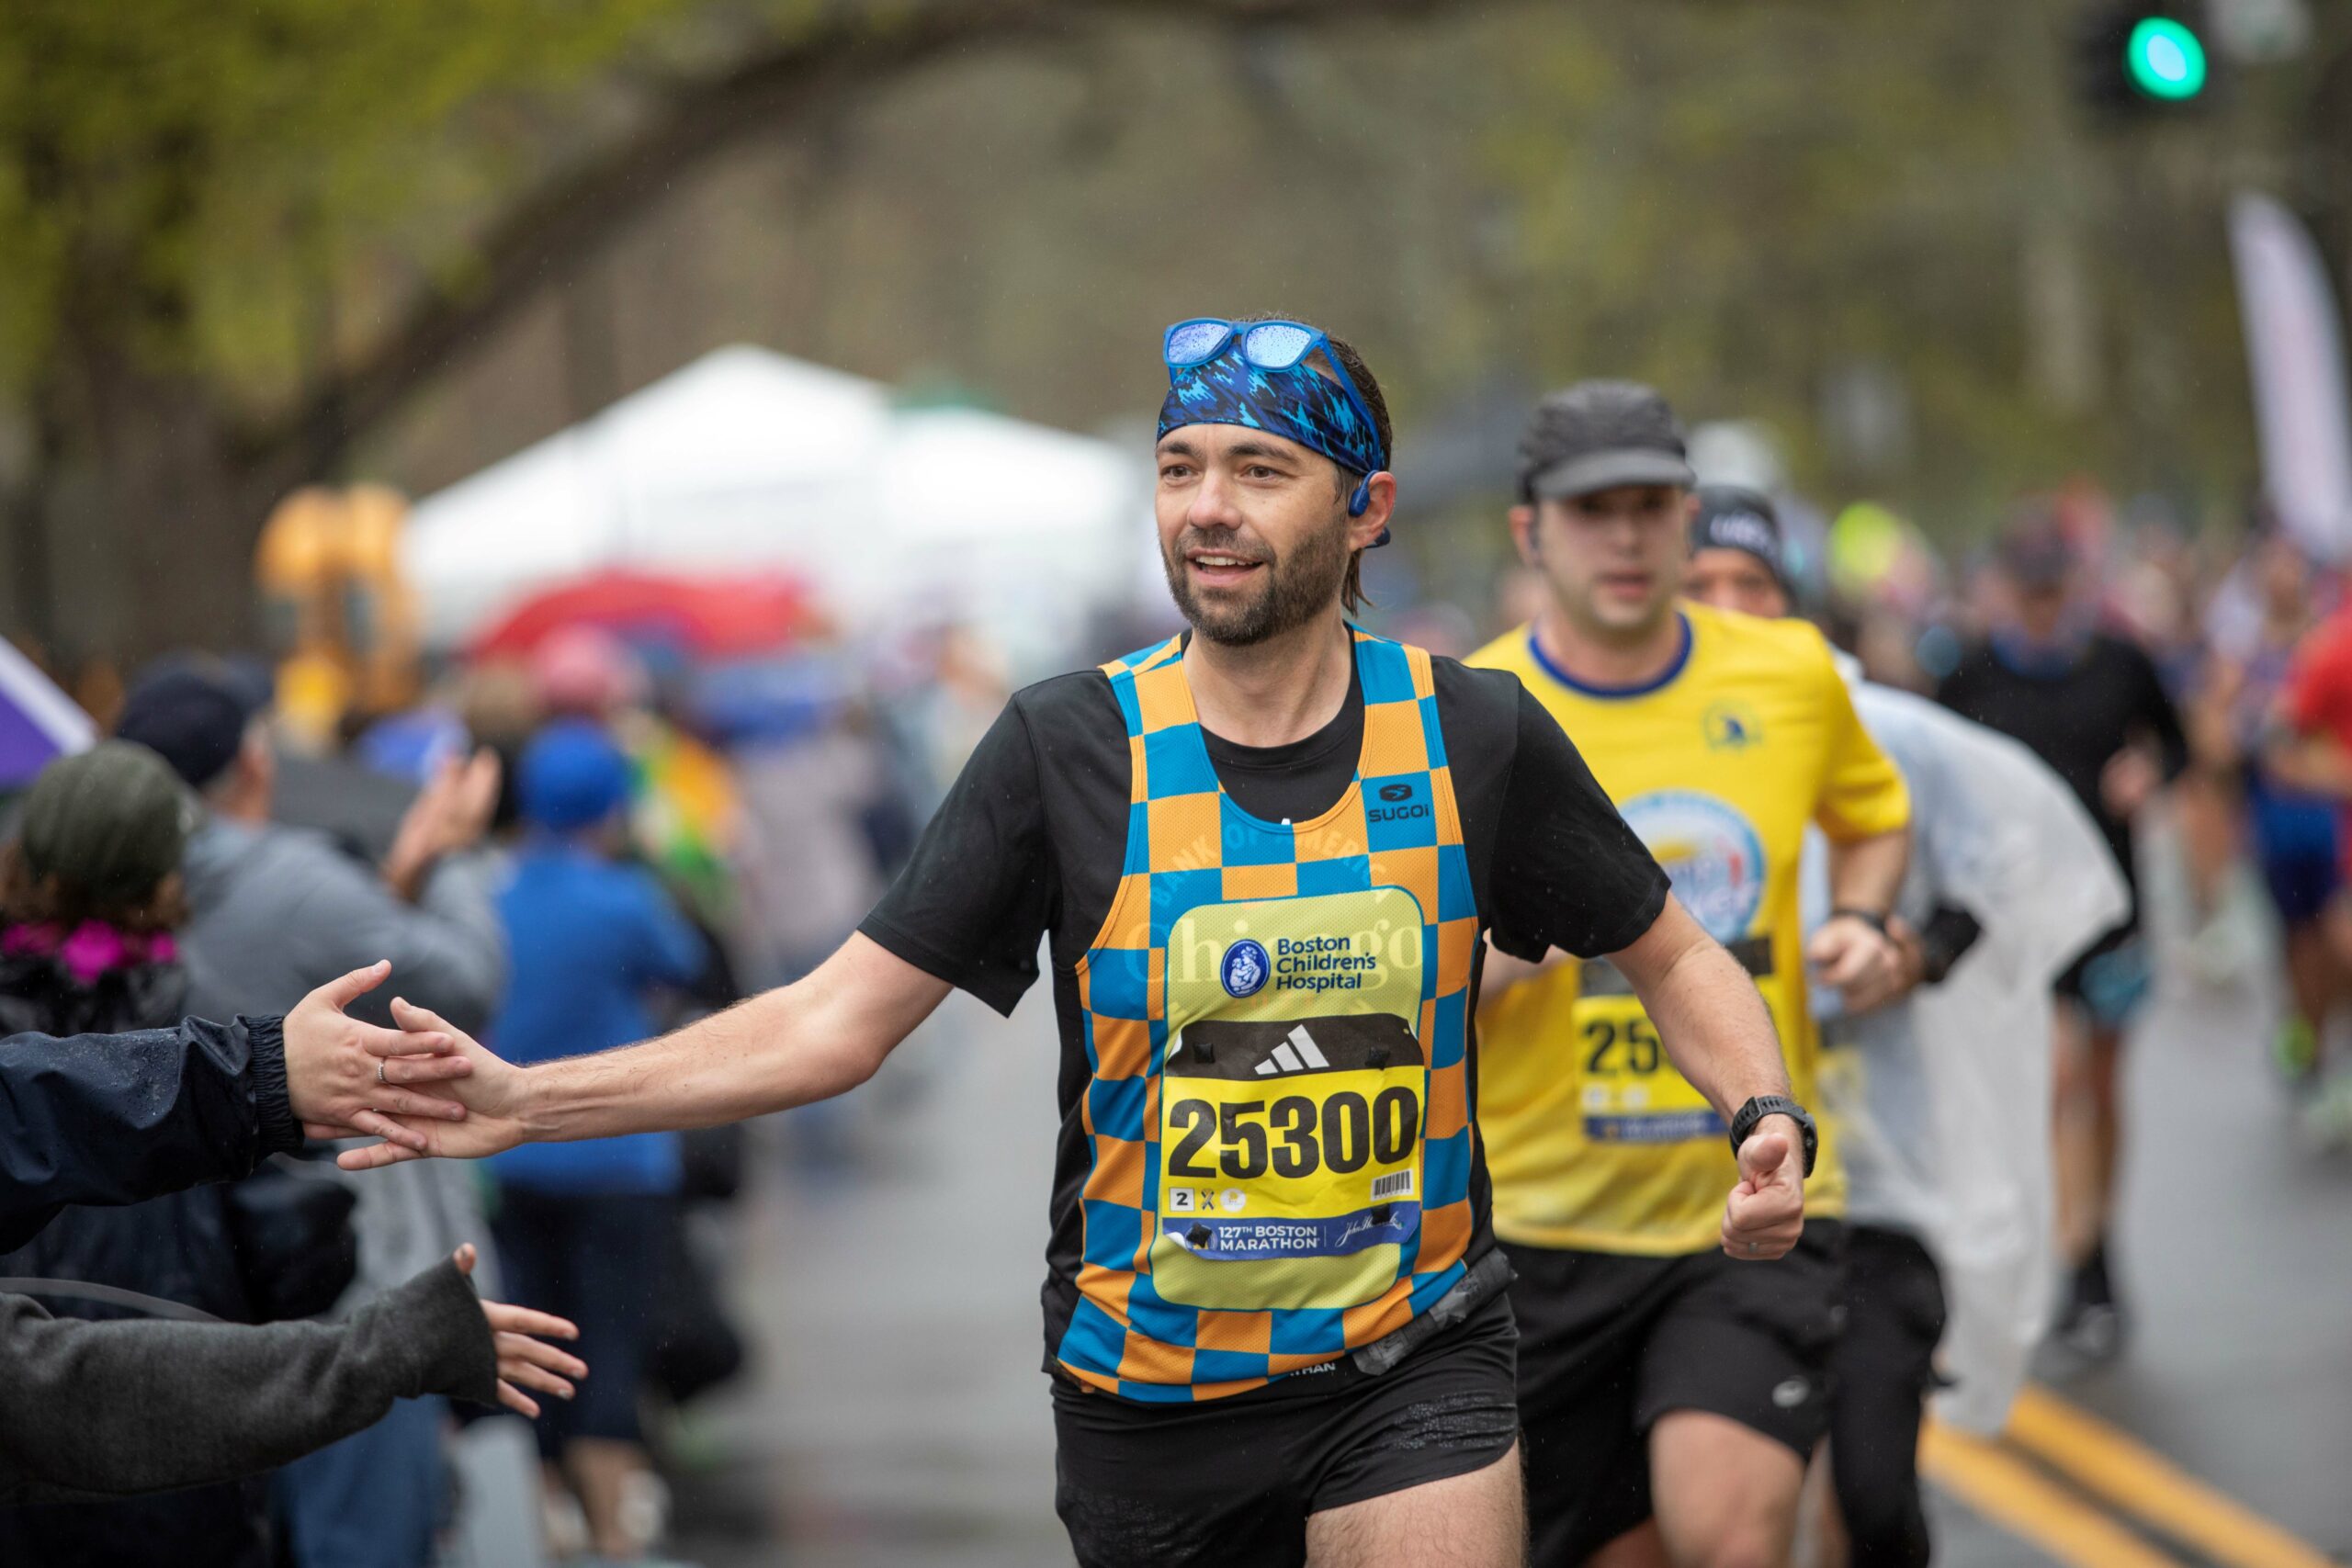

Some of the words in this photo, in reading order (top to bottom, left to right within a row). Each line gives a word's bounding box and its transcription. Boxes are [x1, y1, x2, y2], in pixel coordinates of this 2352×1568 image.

[1278, 936, 1350, 955] Boston
[1276, 953, 1376, 974] Children's
[1276, 973, 1362, 993] Hospital
[1169, 1086, 1419, 1179] 25300
[1176, 1192, 1188, 1205] 2
[1218, 1226, 1252, 1238] 127TH
[1255, 1225, 1317, 1237] BOSTON
[1219, 1237, 1317, 1251] MARATHON
